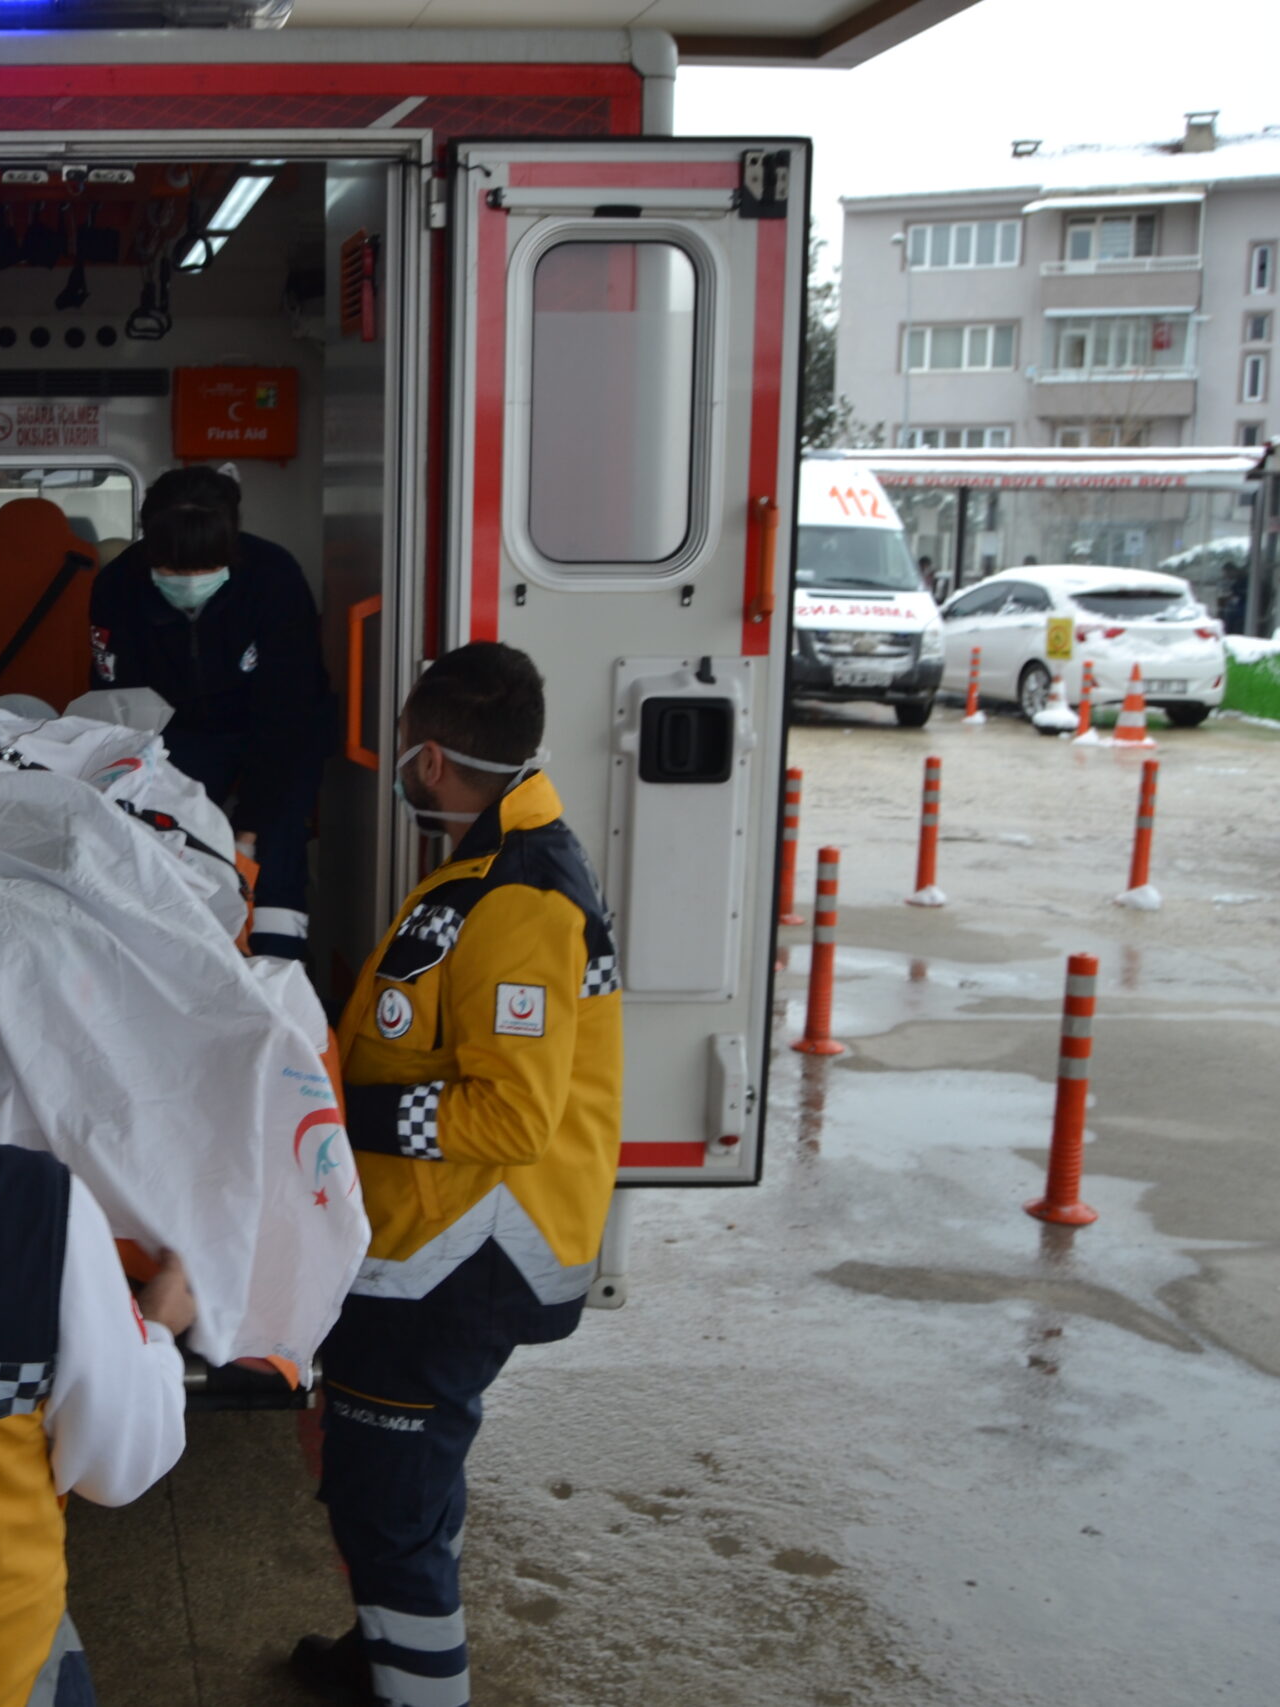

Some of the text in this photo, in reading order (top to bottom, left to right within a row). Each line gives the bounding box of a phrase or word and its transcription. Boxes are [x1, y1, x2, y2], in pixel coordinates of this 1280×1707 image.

[207, 427, 267, 440] First Aid
[829, 485, 888, 519] 112
